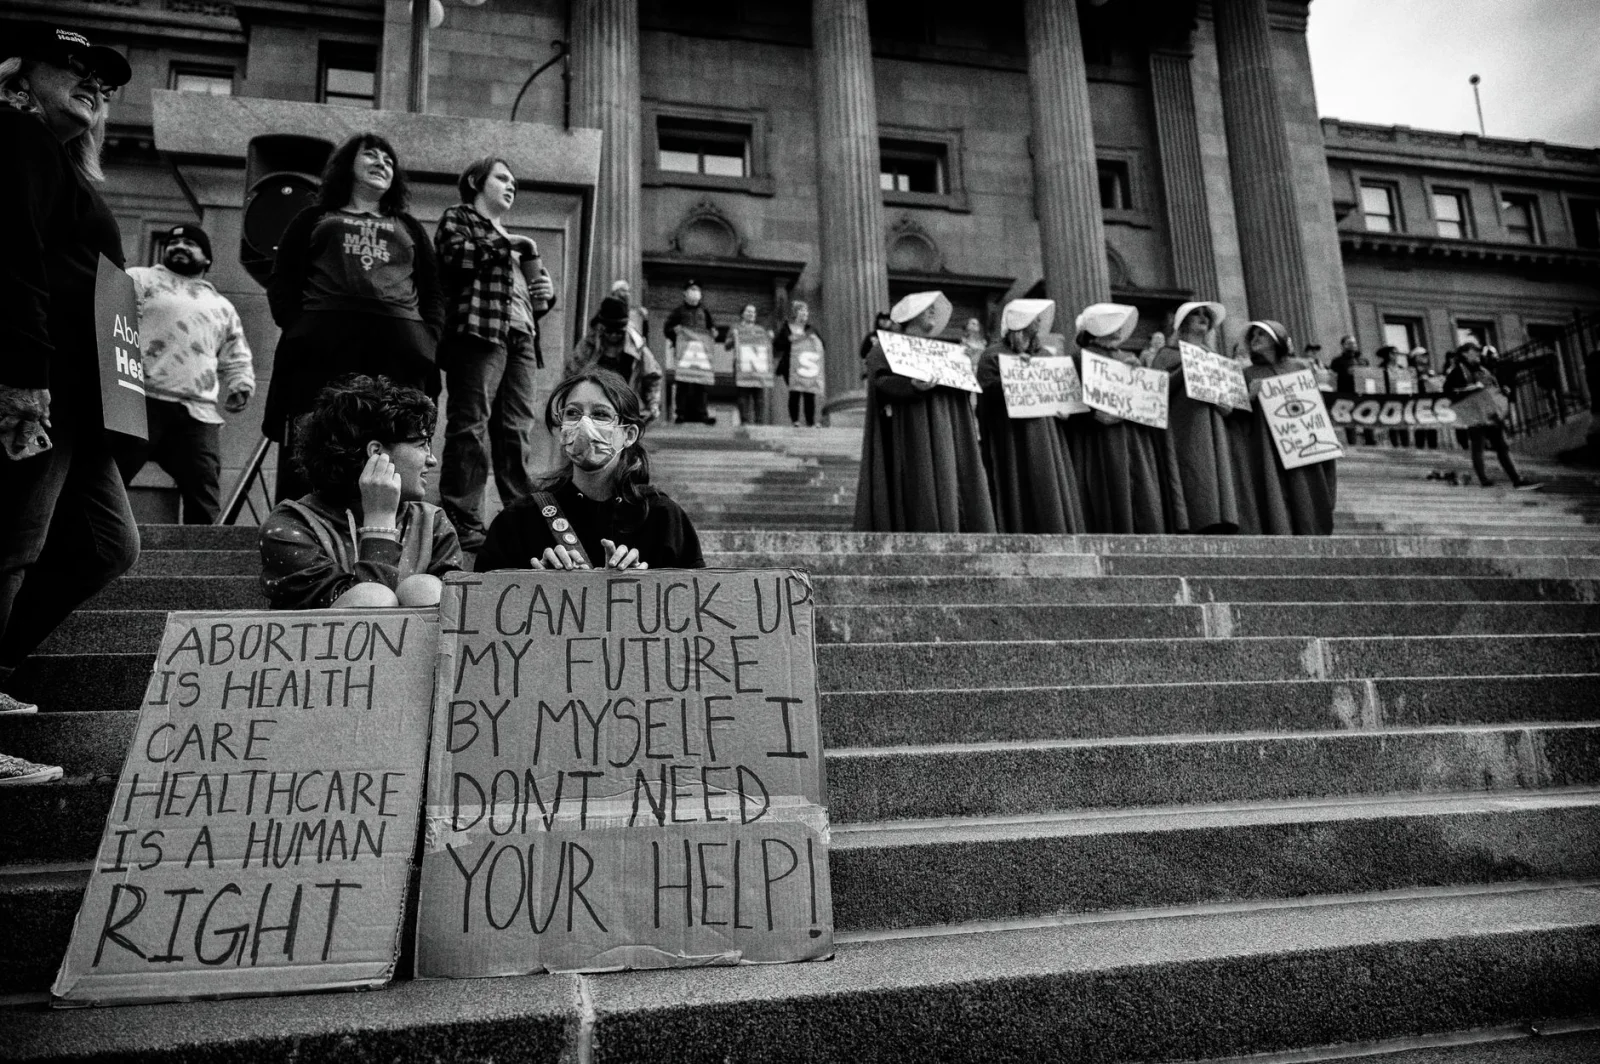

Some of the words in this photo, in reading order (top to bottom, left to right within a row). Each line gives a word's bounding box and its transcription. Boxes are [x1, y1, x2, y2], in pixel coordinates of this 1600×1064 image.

[343, 243, 390, 262] TEARS
[344, 233, 387, 250] MALE
[360, 226, 377, 238] IN
[678, 340, 712, 369] A
[740, 345, 769, 373] N
[796, 351, 820, 378] S
[1273, 422, 1298, 436] We
[1300, 413, 1326, 431] Will
[1331, 398, 1457, 425] BODIES
[1280, 437, 1303, 455] Die
[442, 580, 483, 634] I
[496, 583, 588, 636] CAN
[606, 577, 737, 634] FUCK
[754, 576, 813, 636] UP
[165, 617, 410, 666] ABORTION
[147, 670, 200, 708] IS
[220, 665, 376, 711] HEALTH
[454, 638, 534, 698] MY
[566, 635, 763, 694] FUTURE
[145, 719, 278, 764] CARE
[446, 699, 511, 757] BY
[533, 695, 736, 768] MYSELF
[764, 697, 809, 759] I
[122, 769, 406, 823] HEALTHCARE
[451, 768, 605, 836] DONT
[629, 763, 771, 828] NEED
[100, 828, 165, 874] IS
[184, 825, 216, 869] A
[242, 817, 387, 870] HUMAN
[446, 840, 609, 934] YOUR
[652, 838, 822, 939] HELP!
[92, 878, 363, 968] RIGHT
